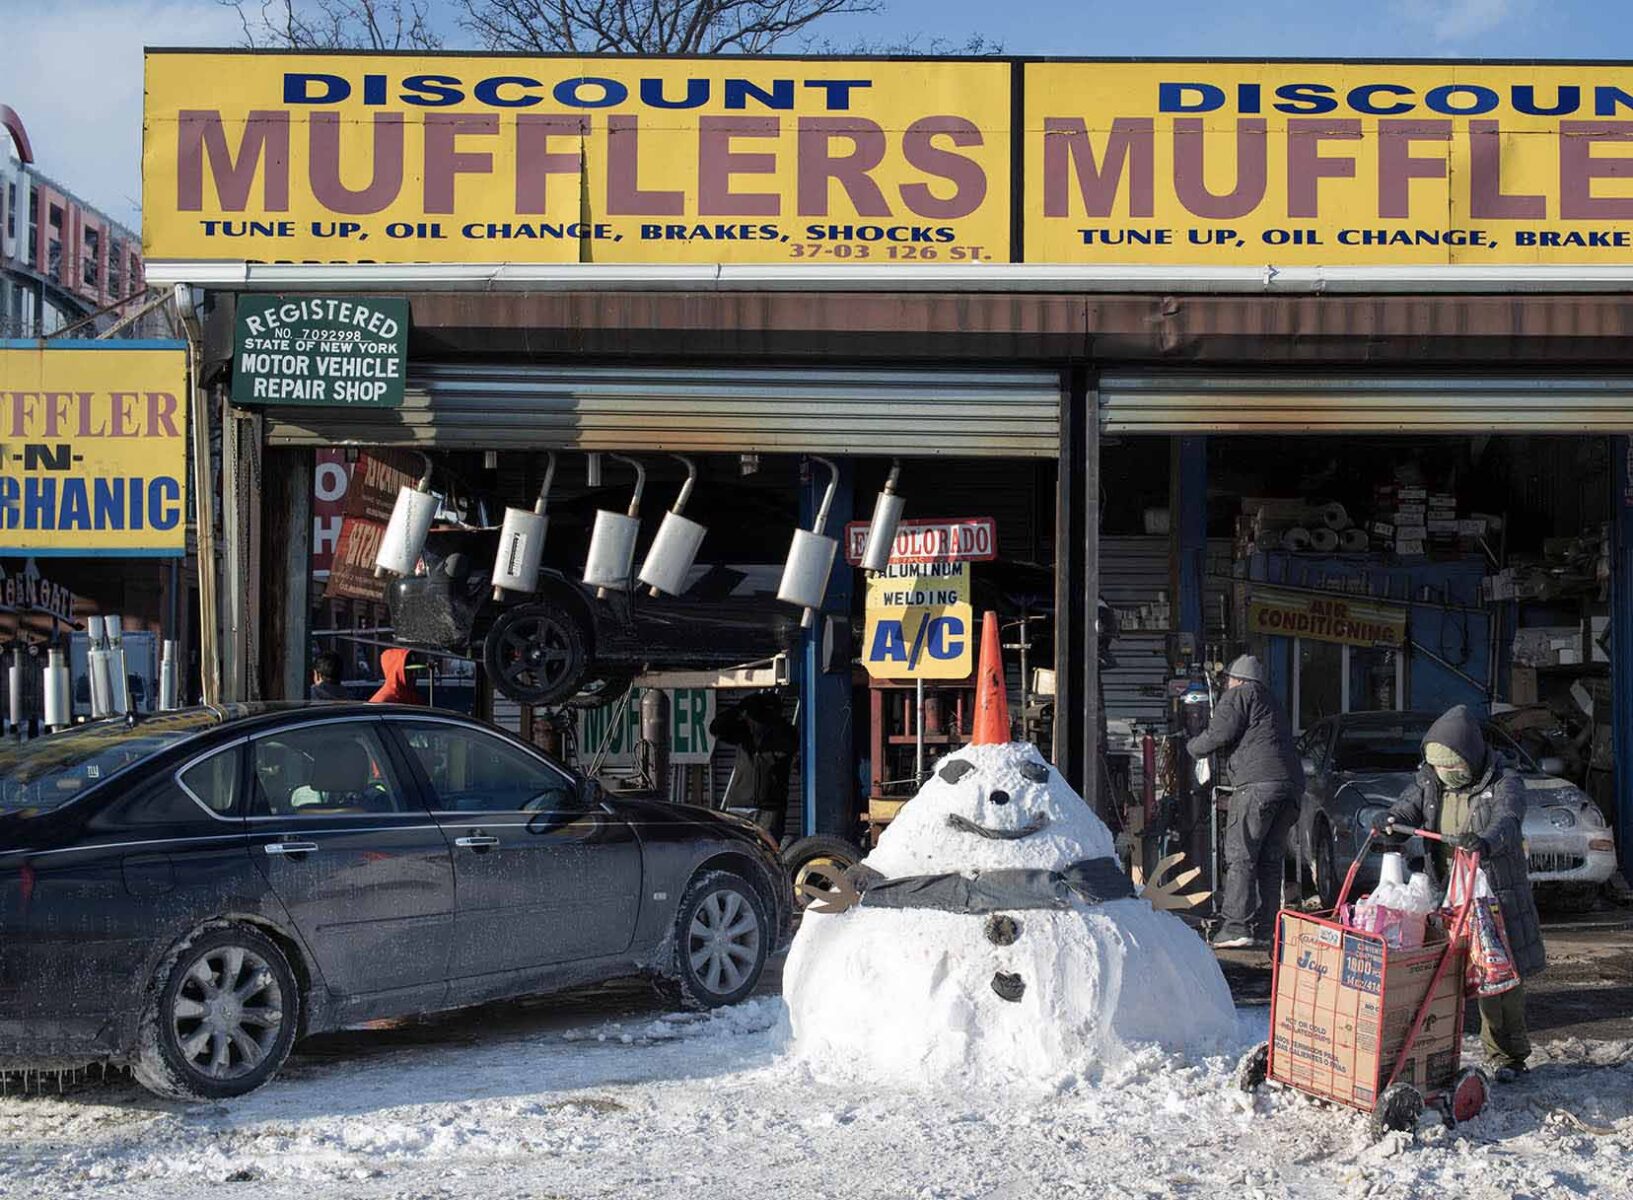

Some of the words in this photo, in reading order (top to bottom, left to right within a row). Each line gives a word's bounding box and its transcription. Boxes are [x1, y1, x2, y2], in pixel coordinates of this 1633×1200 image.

[283, 73, 872, 110] DISCOUNT
[1159, 82, 1633, 117] DISCOUN
[177, 109, 988, 220] MUFFLERS
[1044, 117, 1633, 221] MUFFLE
[200, 220, 295, 237] TUNE
[311, 222, 369, 241] UP,
[386, 223, 447, 239] OIL
[462, 223, 625, 243] CHANGE,
[641, 224, 790, 244] BRAKES,
[806, 225, 956, 243] SHOCKS
[1078, 228, 1174, 246] TUNE
[1188, 229, 1245, 248] UP,
[1261, 229, 1324, 247] OIL
[1337, 230, 1499, 249] CHANGE,
[1515, 231, 1633, 247] BRAKE
[789, 244, 871, 260] 37-03
[885, 245, 939, 261] 126
[949, 246, 992, 260] ST.
[245, 299, 399, 339] REGISTERED
[244, 338, 290, 351] STATE
[295, 341, 316, 352] OF
[320, 342, 357, 353] NEW
[358, 343, 399, 354] YORK
[274, 327, 293, 340] NO.
[241, 353, 310, 376] MOTOR
[316, 356, 400, 378] VEHICLE
[253, 377, 326, 400] REPAIR
[333, 381, 388, 403] SHOP
[884, 590, 959, 606] WELDING
[1257, 607, 1395, 643] CONDITIONING
[869, 612, 966, 671] A/C
